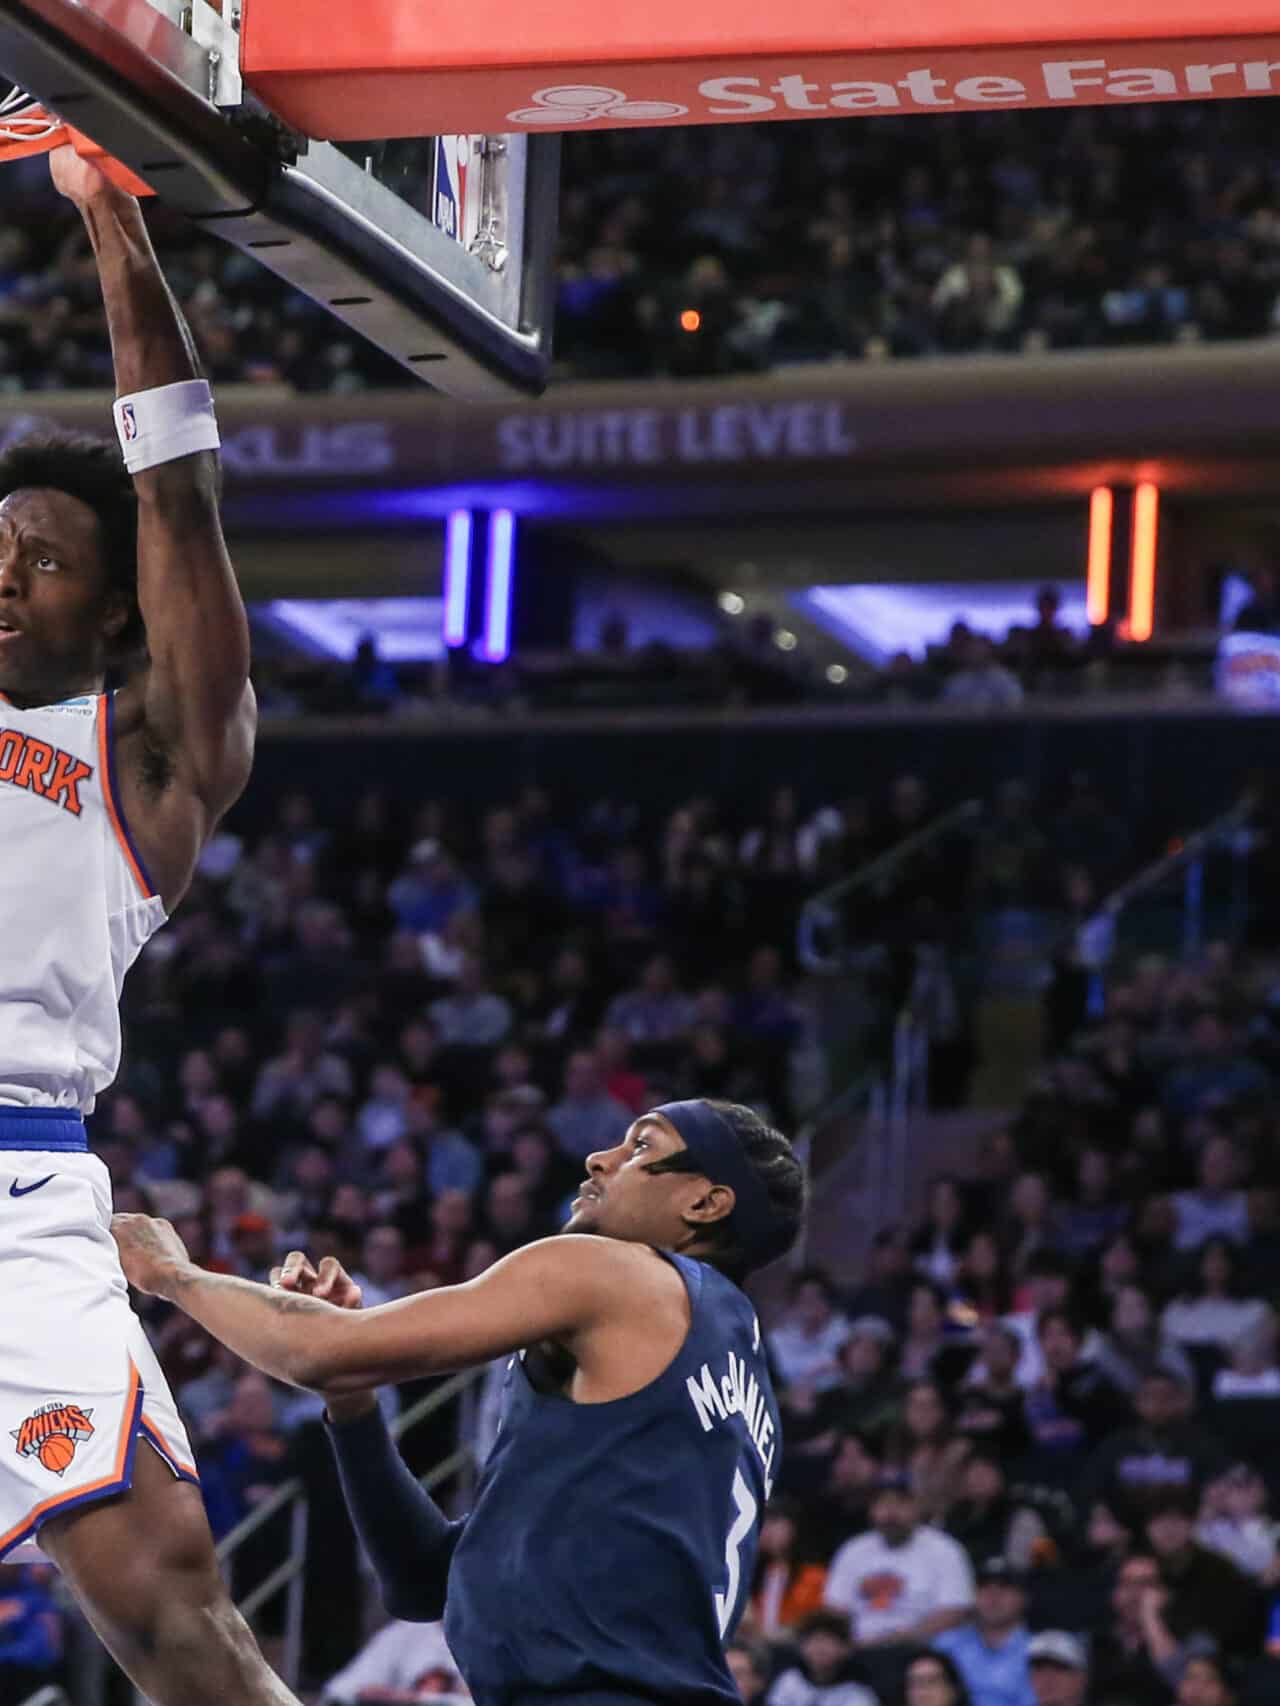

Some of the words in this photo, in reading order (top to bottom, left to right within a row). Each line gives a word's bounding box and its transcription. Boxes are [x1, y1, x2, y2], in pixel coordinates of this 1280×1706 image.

[698, 68, 1026, 115] State
[497, 412, 658, 467] SUITE
[678, 403, 856, 458] LEVEL
[16, 1404, 95, 1456] KNICKS
